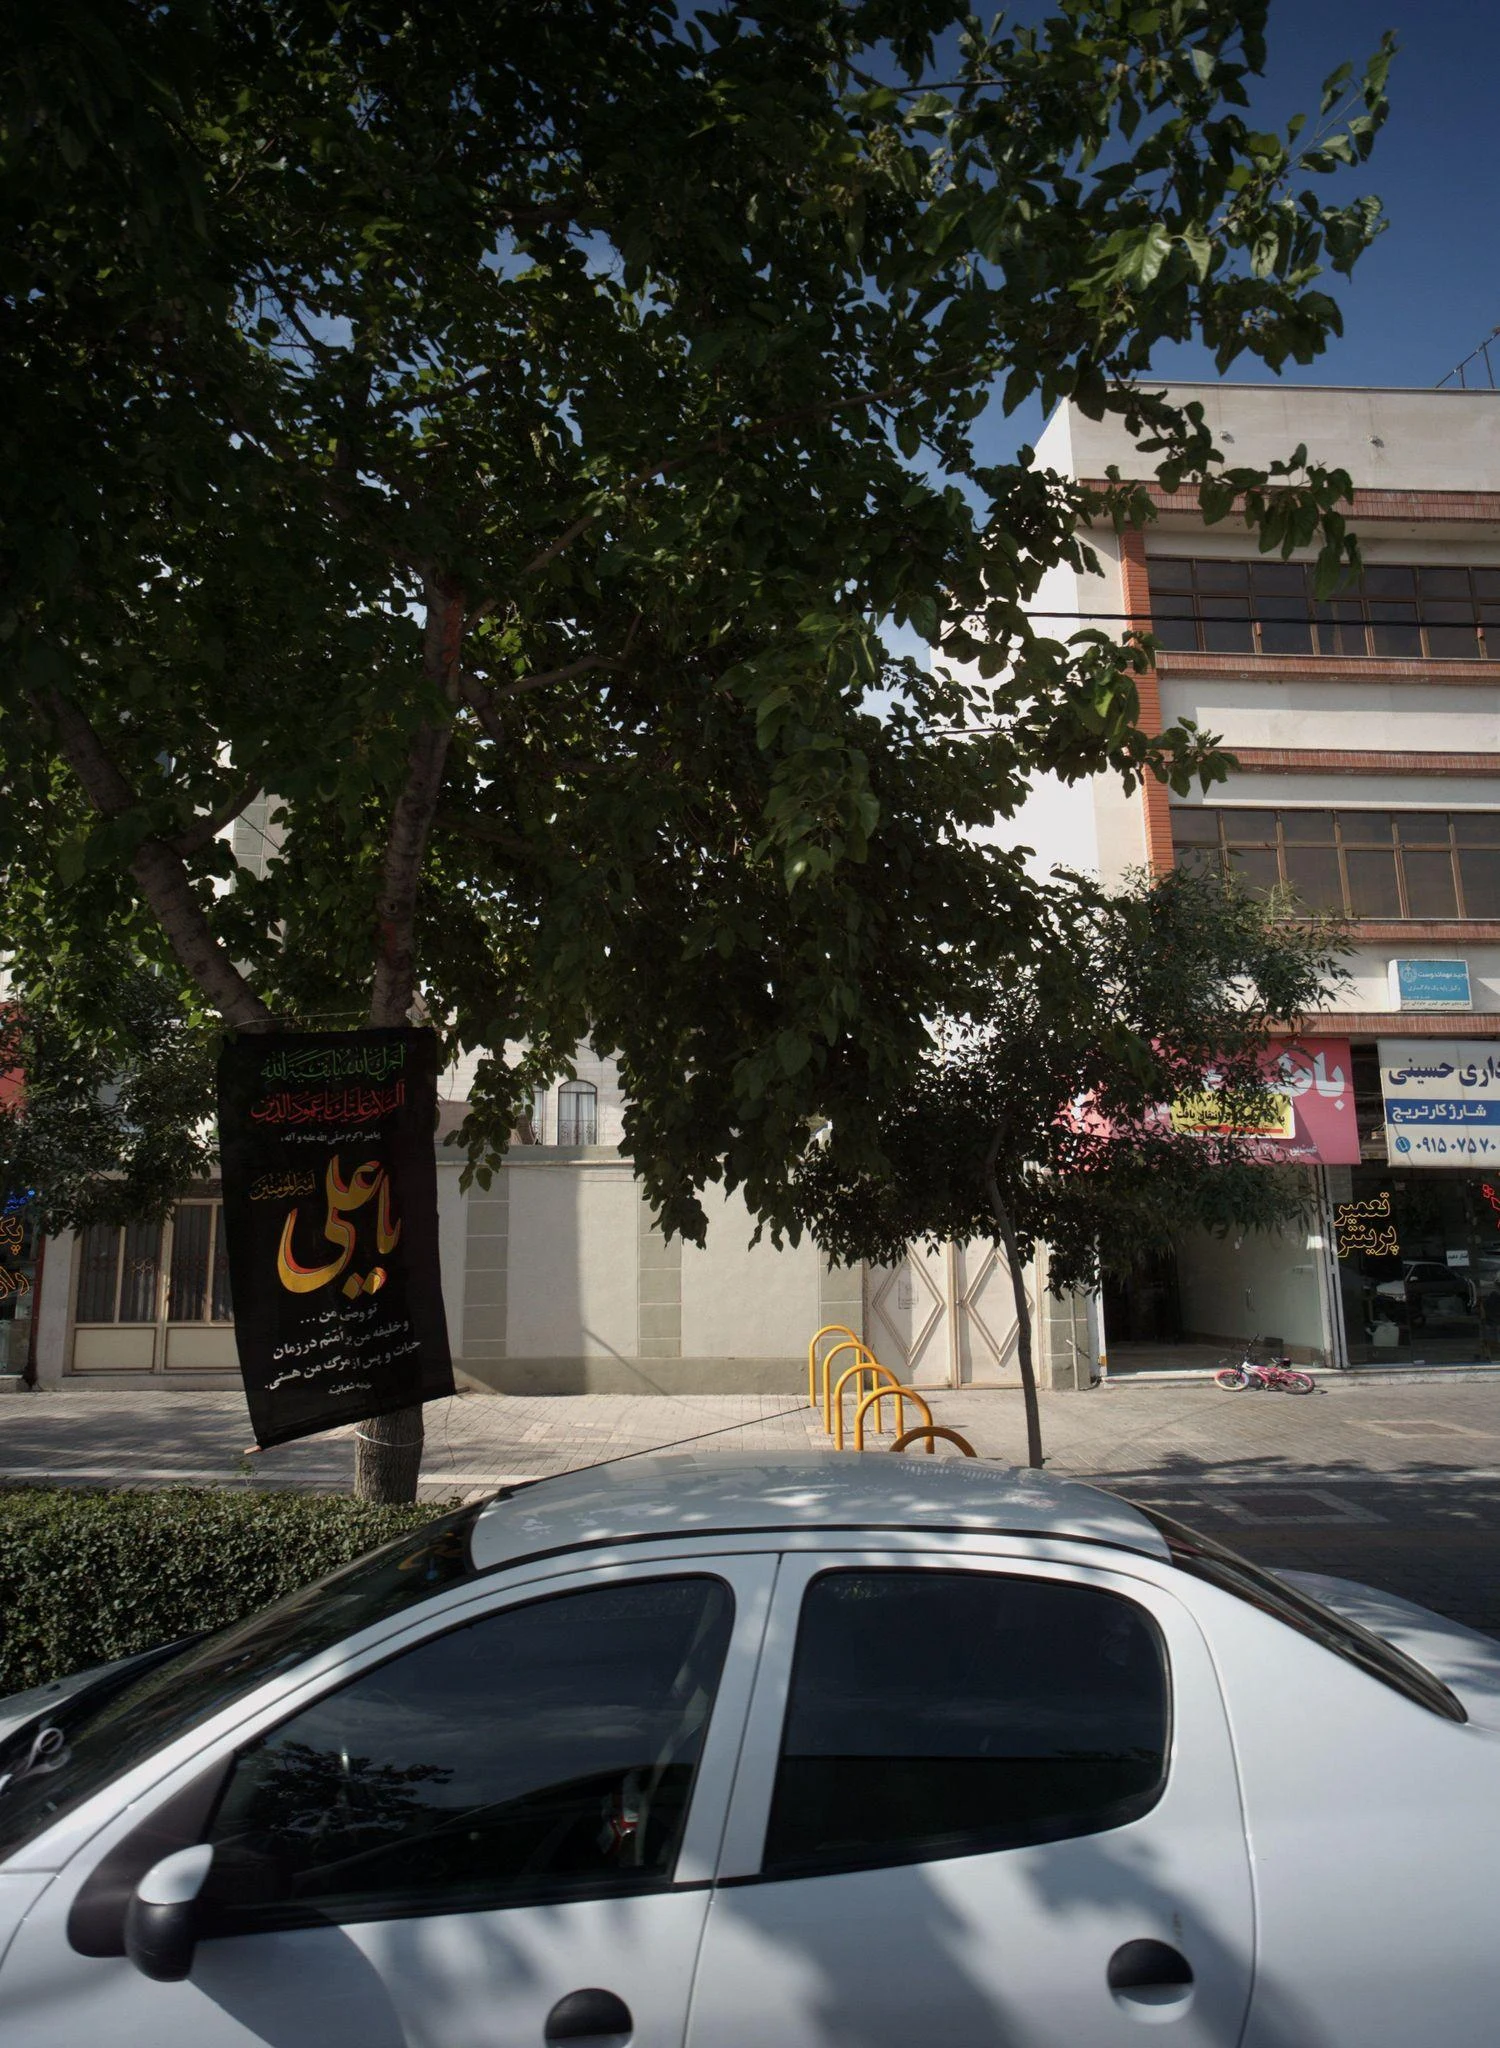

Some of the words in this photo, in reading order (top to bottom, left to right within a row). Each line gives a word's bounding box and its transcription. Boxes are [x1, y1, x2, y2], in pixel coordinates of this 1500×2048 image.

[1388, 1058, 1455, 1085] حسینی
[1392, 1104, 1448, 1122] کارتریج
[1449, 1104, 1487, 1120] شارژ
[1333, 1191, 1391, 1227] تعمیر
[1337, 1224, 1400, 1258] پرینتر
[318, 1310, 338, 1323] من
[373, 1321, 402, 1337] خلیفه
[302, 1338, 317, 1354] در
[353, 1333, 371, 1347] من
[392, 1340, 421, 1356] حیات
[273, 1342, 302, 1360] زمان
[303, 1364, 321, 1378] من
[323, 1355, 350, 1371] مرگ
